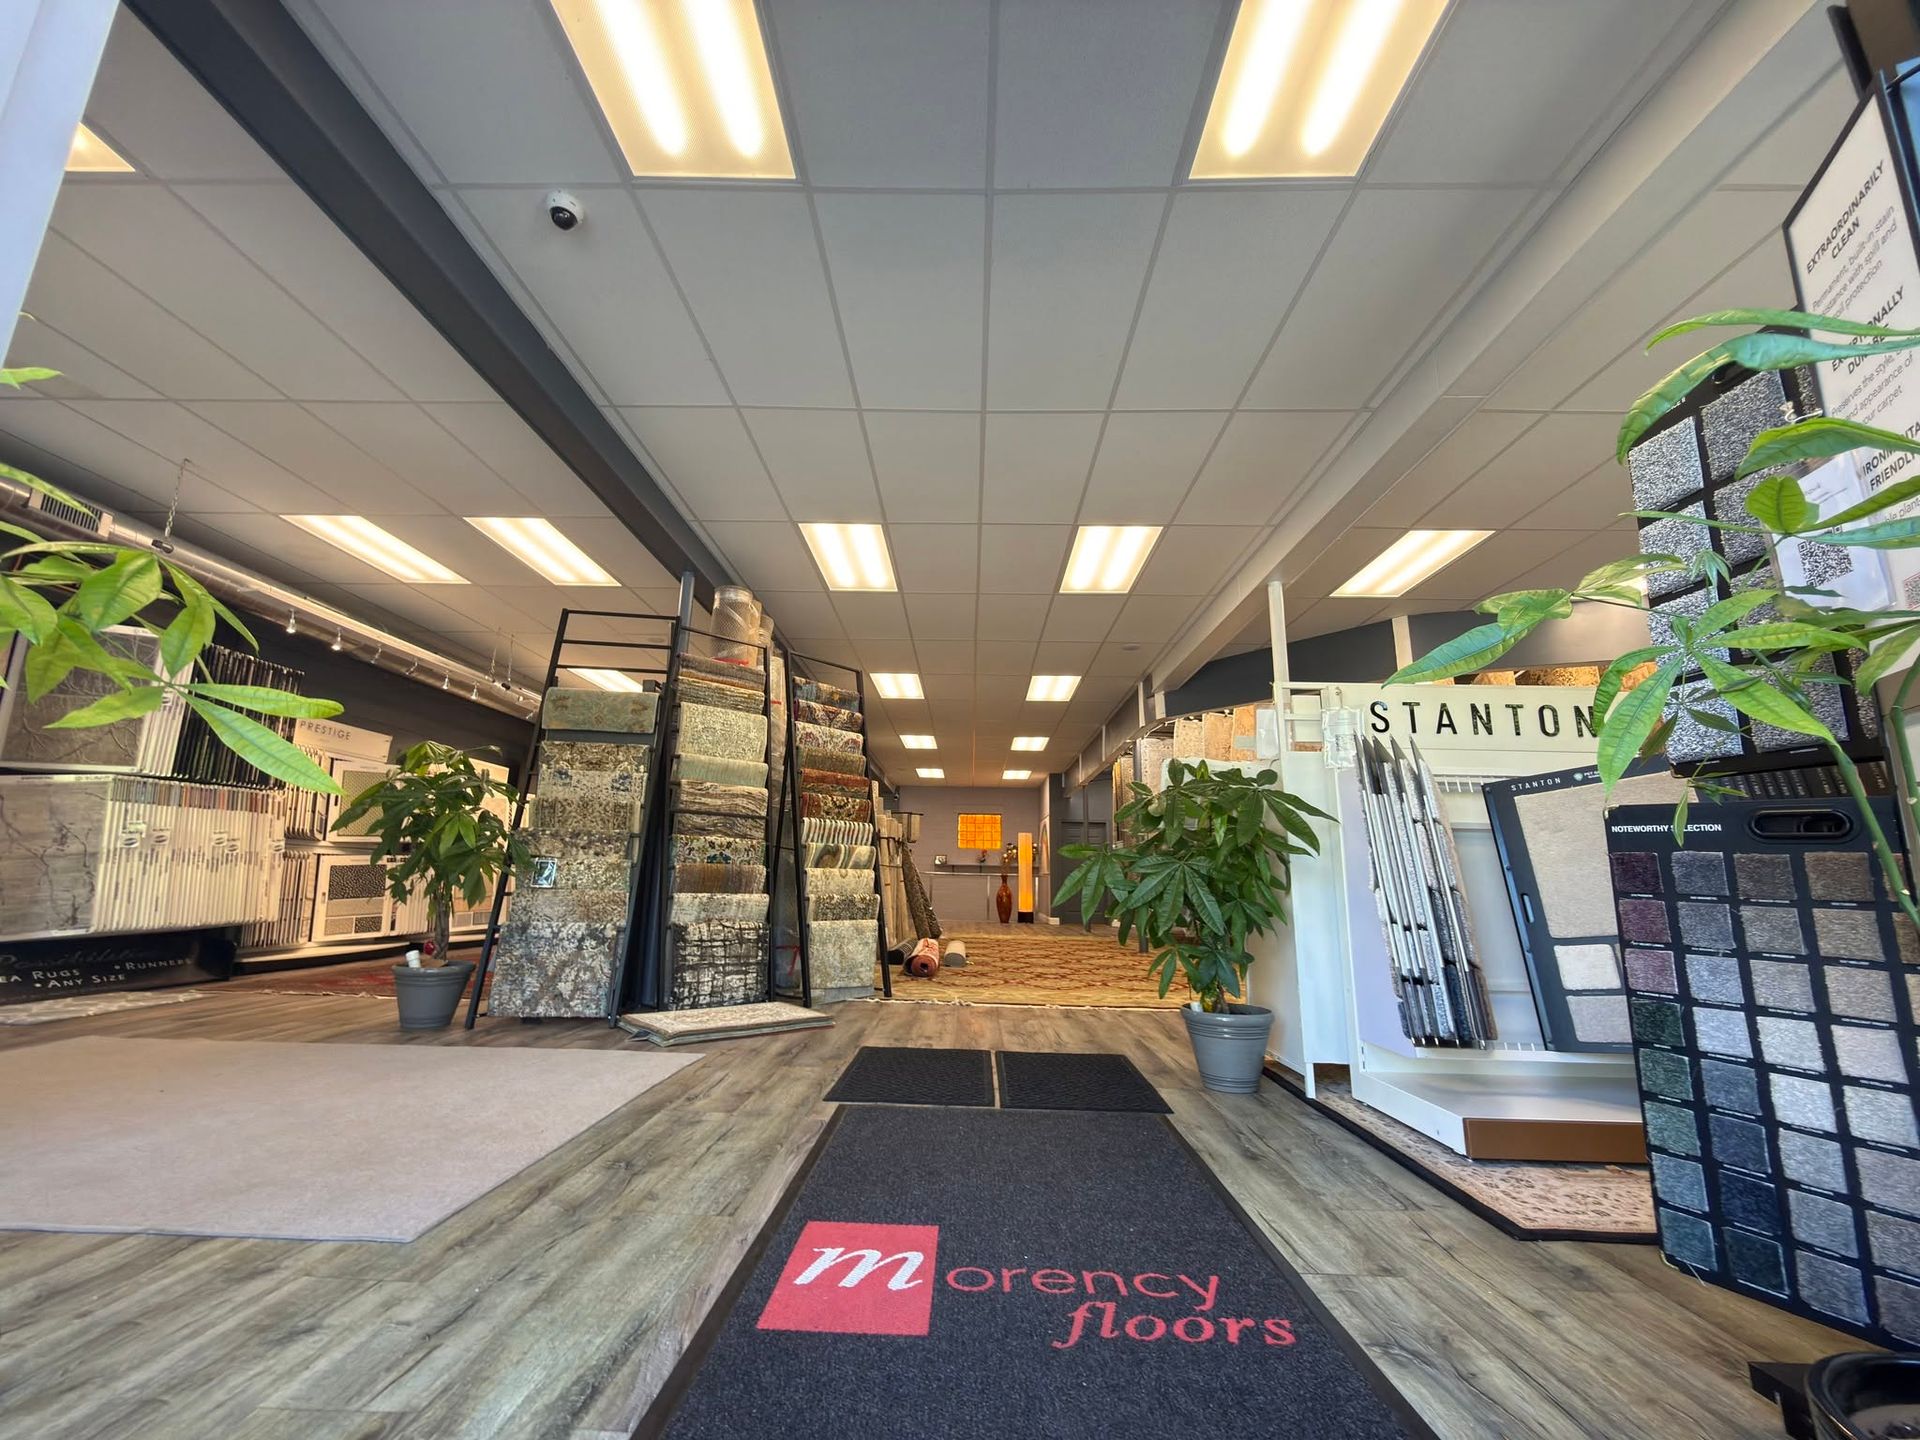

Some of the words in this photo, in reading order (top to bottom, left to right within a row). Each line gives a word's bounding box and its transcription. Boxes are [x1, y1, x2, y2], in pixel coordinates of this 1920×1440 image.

[1806, 159, 1884, 274] EXTRAORDINARILY
[1831, 216, 1860, 259] CLEAN
[1860, 365, 1904, 411] appearance
[1877, 384, 1903, 413] carpet
[300, 720, 352, 741] PRESTIGE
[1370, 700, 1597, 738] STANTON
[1511, 777, 1561, 791] STANTON
[1611, 824, 1668, 833] NOTEWORTHY
[1051, 1300, 1297, 1350] floors
